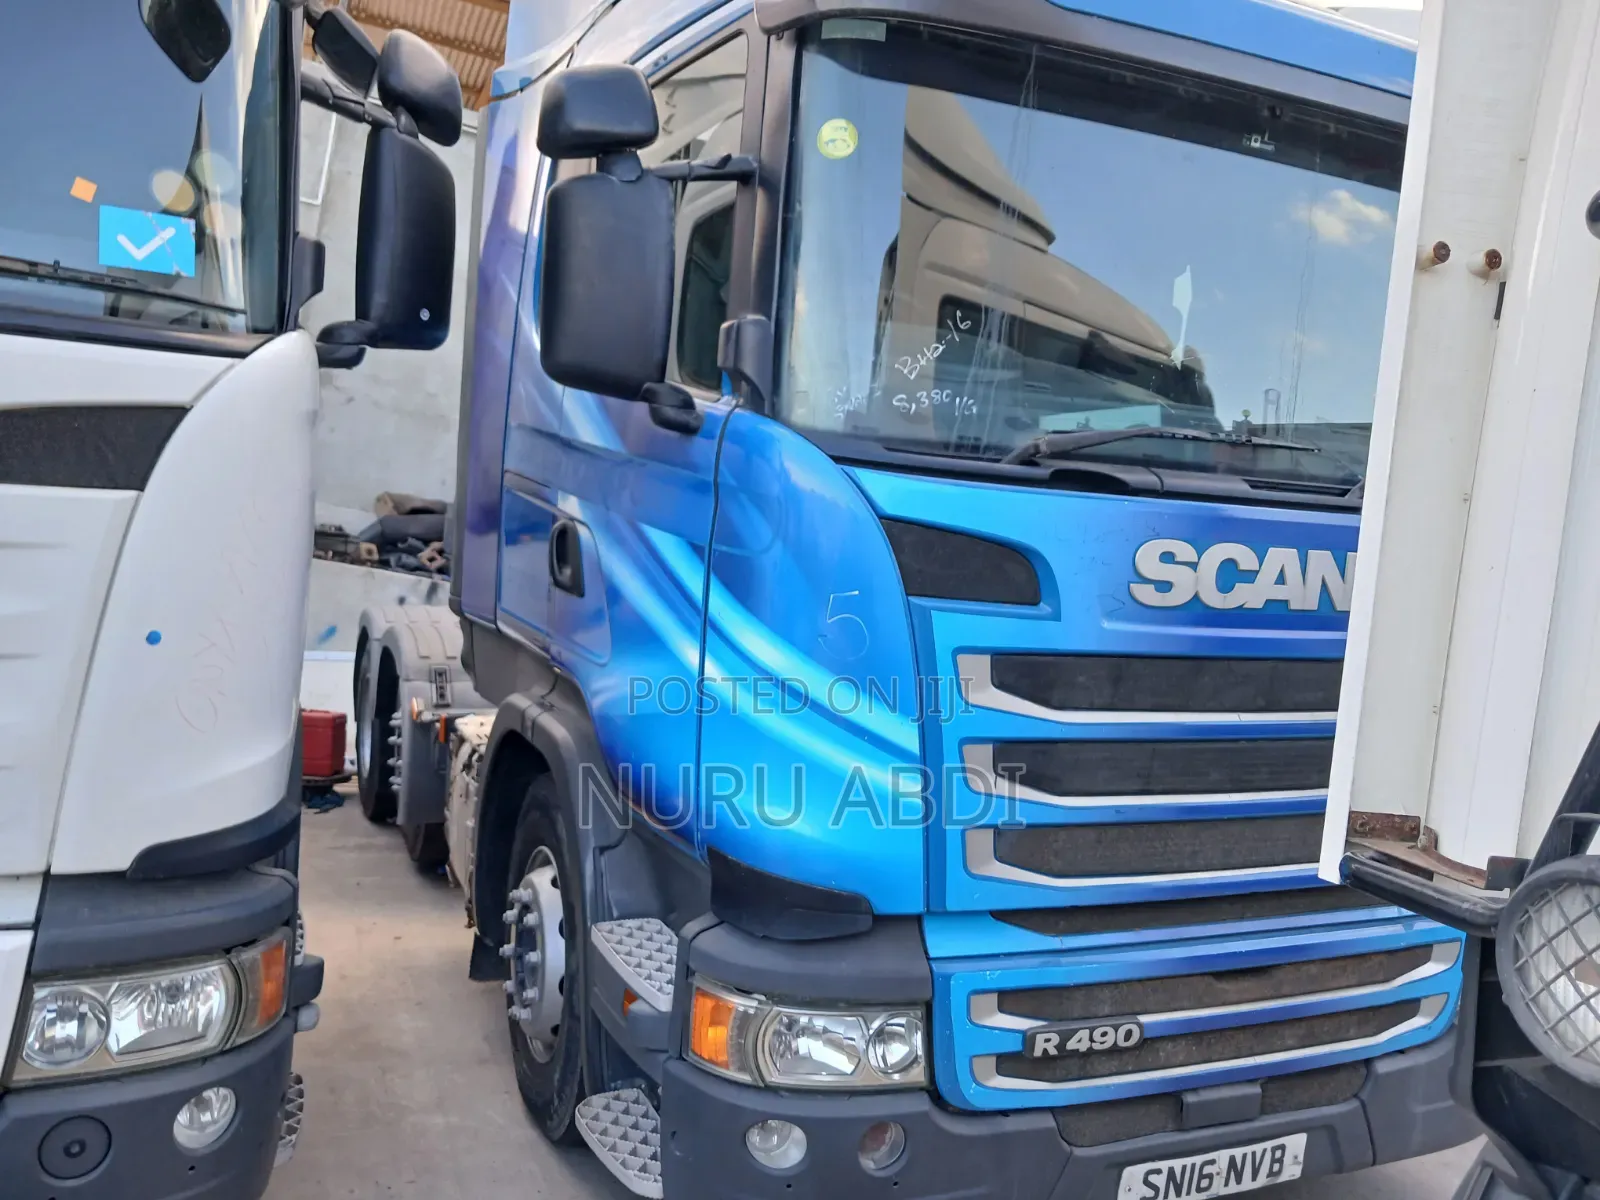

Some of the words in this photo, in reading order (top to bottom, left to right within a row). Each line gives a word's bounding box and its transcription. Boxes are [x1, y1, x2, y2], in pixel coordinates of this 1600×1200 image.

[1129, 538, 1358, 611] SCAN
[818, 590, 869, 660] 5
[1033, 1032, 1060, 1057] R
[1065, 1023, 1140, 1052] 490
[1139, 1157, 1218, 1200] SN16
[1223, 1143, 1287, 1188] NVB
